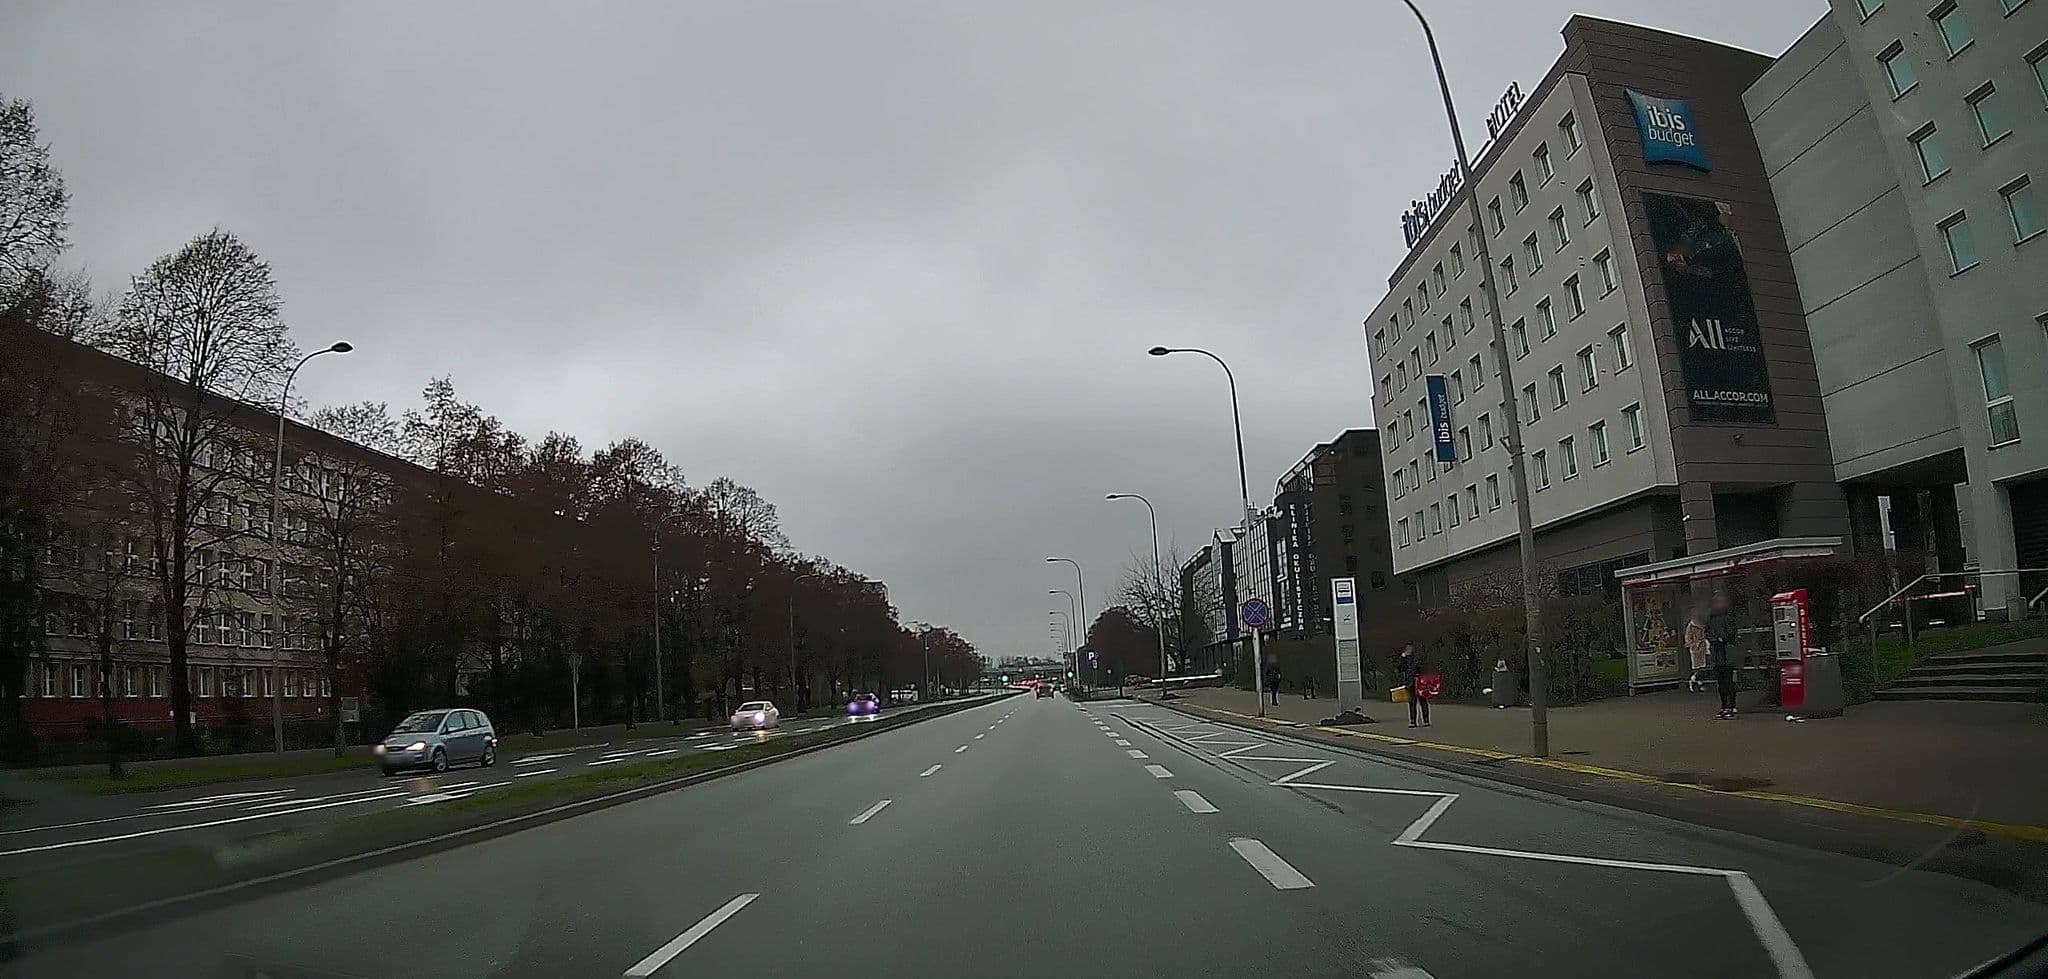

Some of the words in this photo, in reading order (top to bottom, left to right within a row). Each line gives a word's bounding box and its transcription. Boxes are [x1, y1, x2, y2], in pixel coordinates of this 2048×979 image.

[1647, 105, 1685, 130] ibis
[1648, 125, 1695, 147] budget
[1693, 389, 1769, 403] ALL.ACCOR.COM
[1438, 422, 1451, 443] ibis
[1290, 503, 1299, 548] KLINIKA
